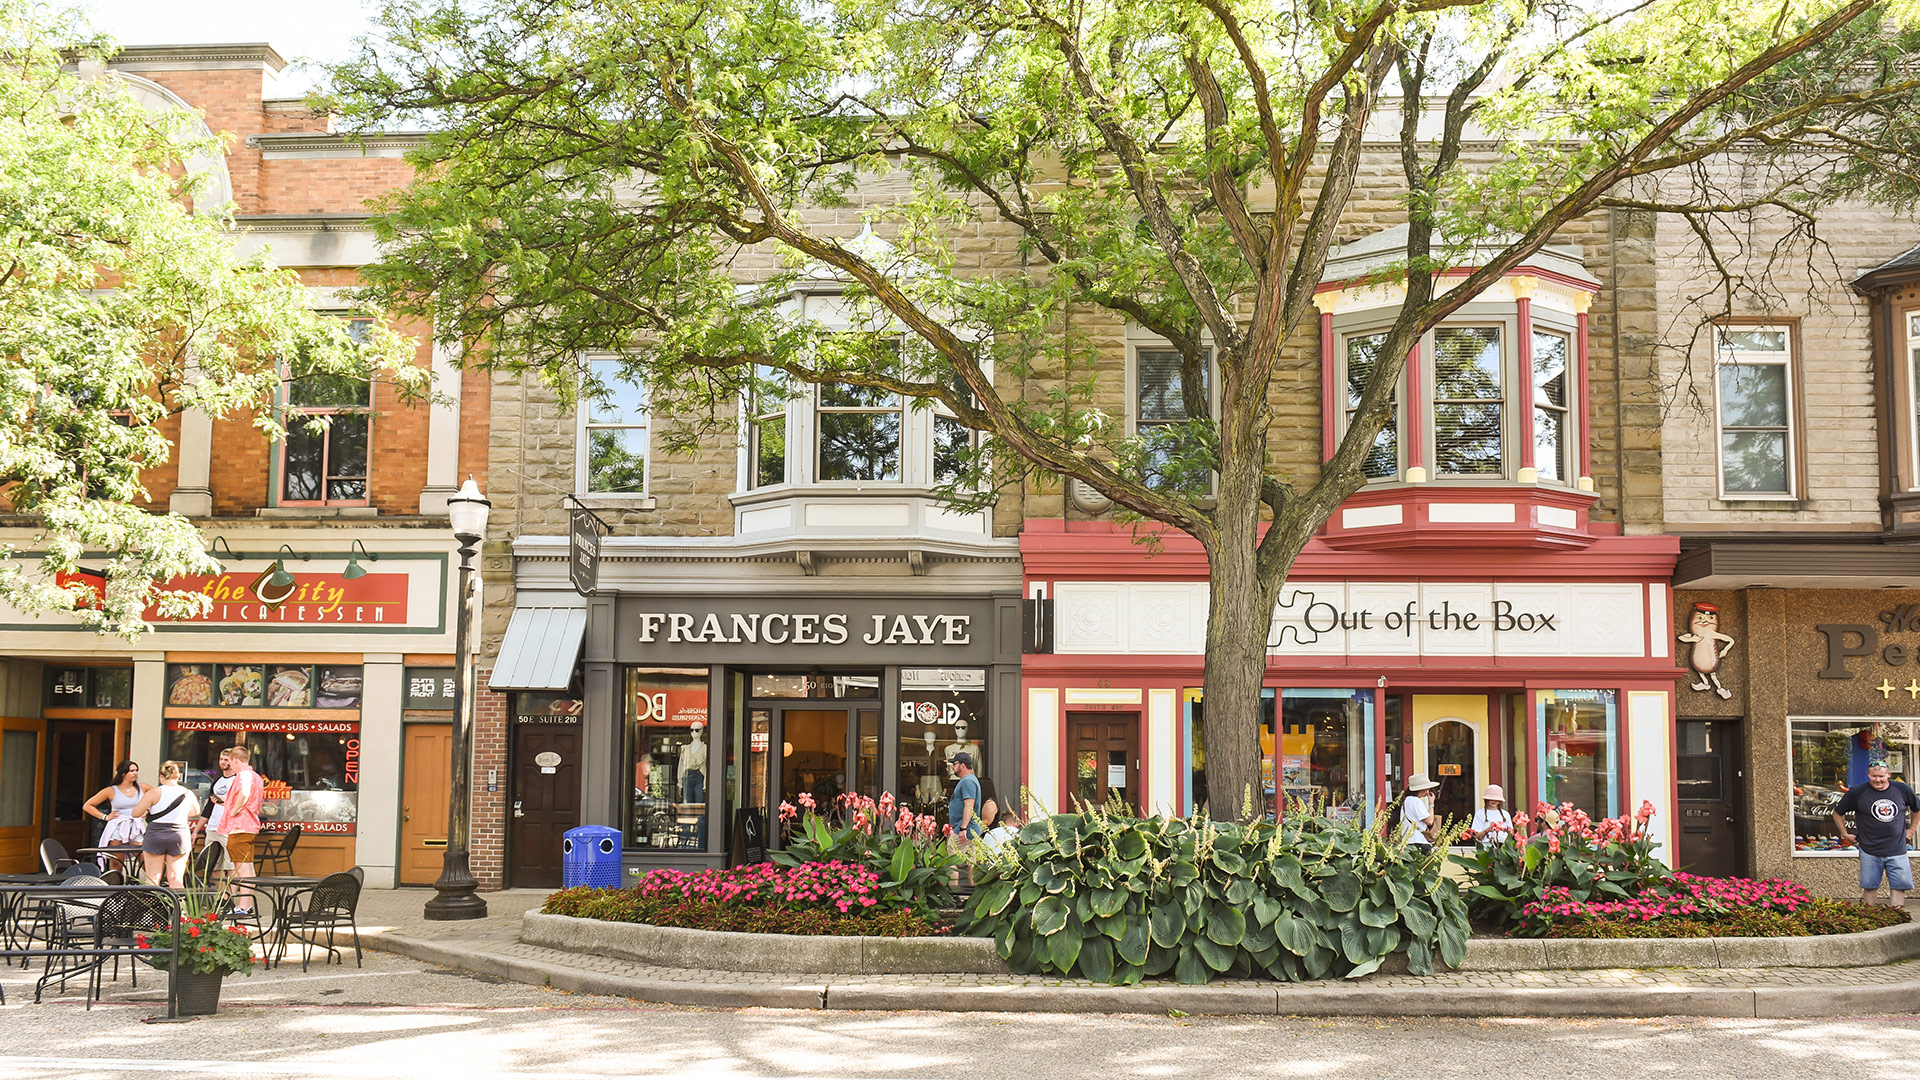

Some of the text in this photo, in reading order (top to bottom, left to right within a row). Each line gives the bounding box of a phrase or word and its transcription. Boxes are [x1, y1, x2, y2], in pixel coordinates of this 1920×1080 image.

[575, 532, 596, 558] FRANCES
[203, 575, 245, 600] the
[638, 612, 971, 646] FRANCES JAYE
[1304, 600, 1557, 638] Out of the Box
[1816, 624, 1920, 679] Pe
[54, 685, 83, 694] E 54
[410, 683, 435, 692] 210
[177, 721, 207, 730] PIZZAS
[213, 722, 244, 731] PANINIS
[251, 723, 280, 731] WRAPS
[317, 723, 352, 732] SALADS
[539, 715, 563, 724] SUITE
[564, 715, 577, 724] 210
[345, 738, 360, 784] OPEN
[260, 823, 276, 831] APS
[313, 823, 348, 832] SALADS
